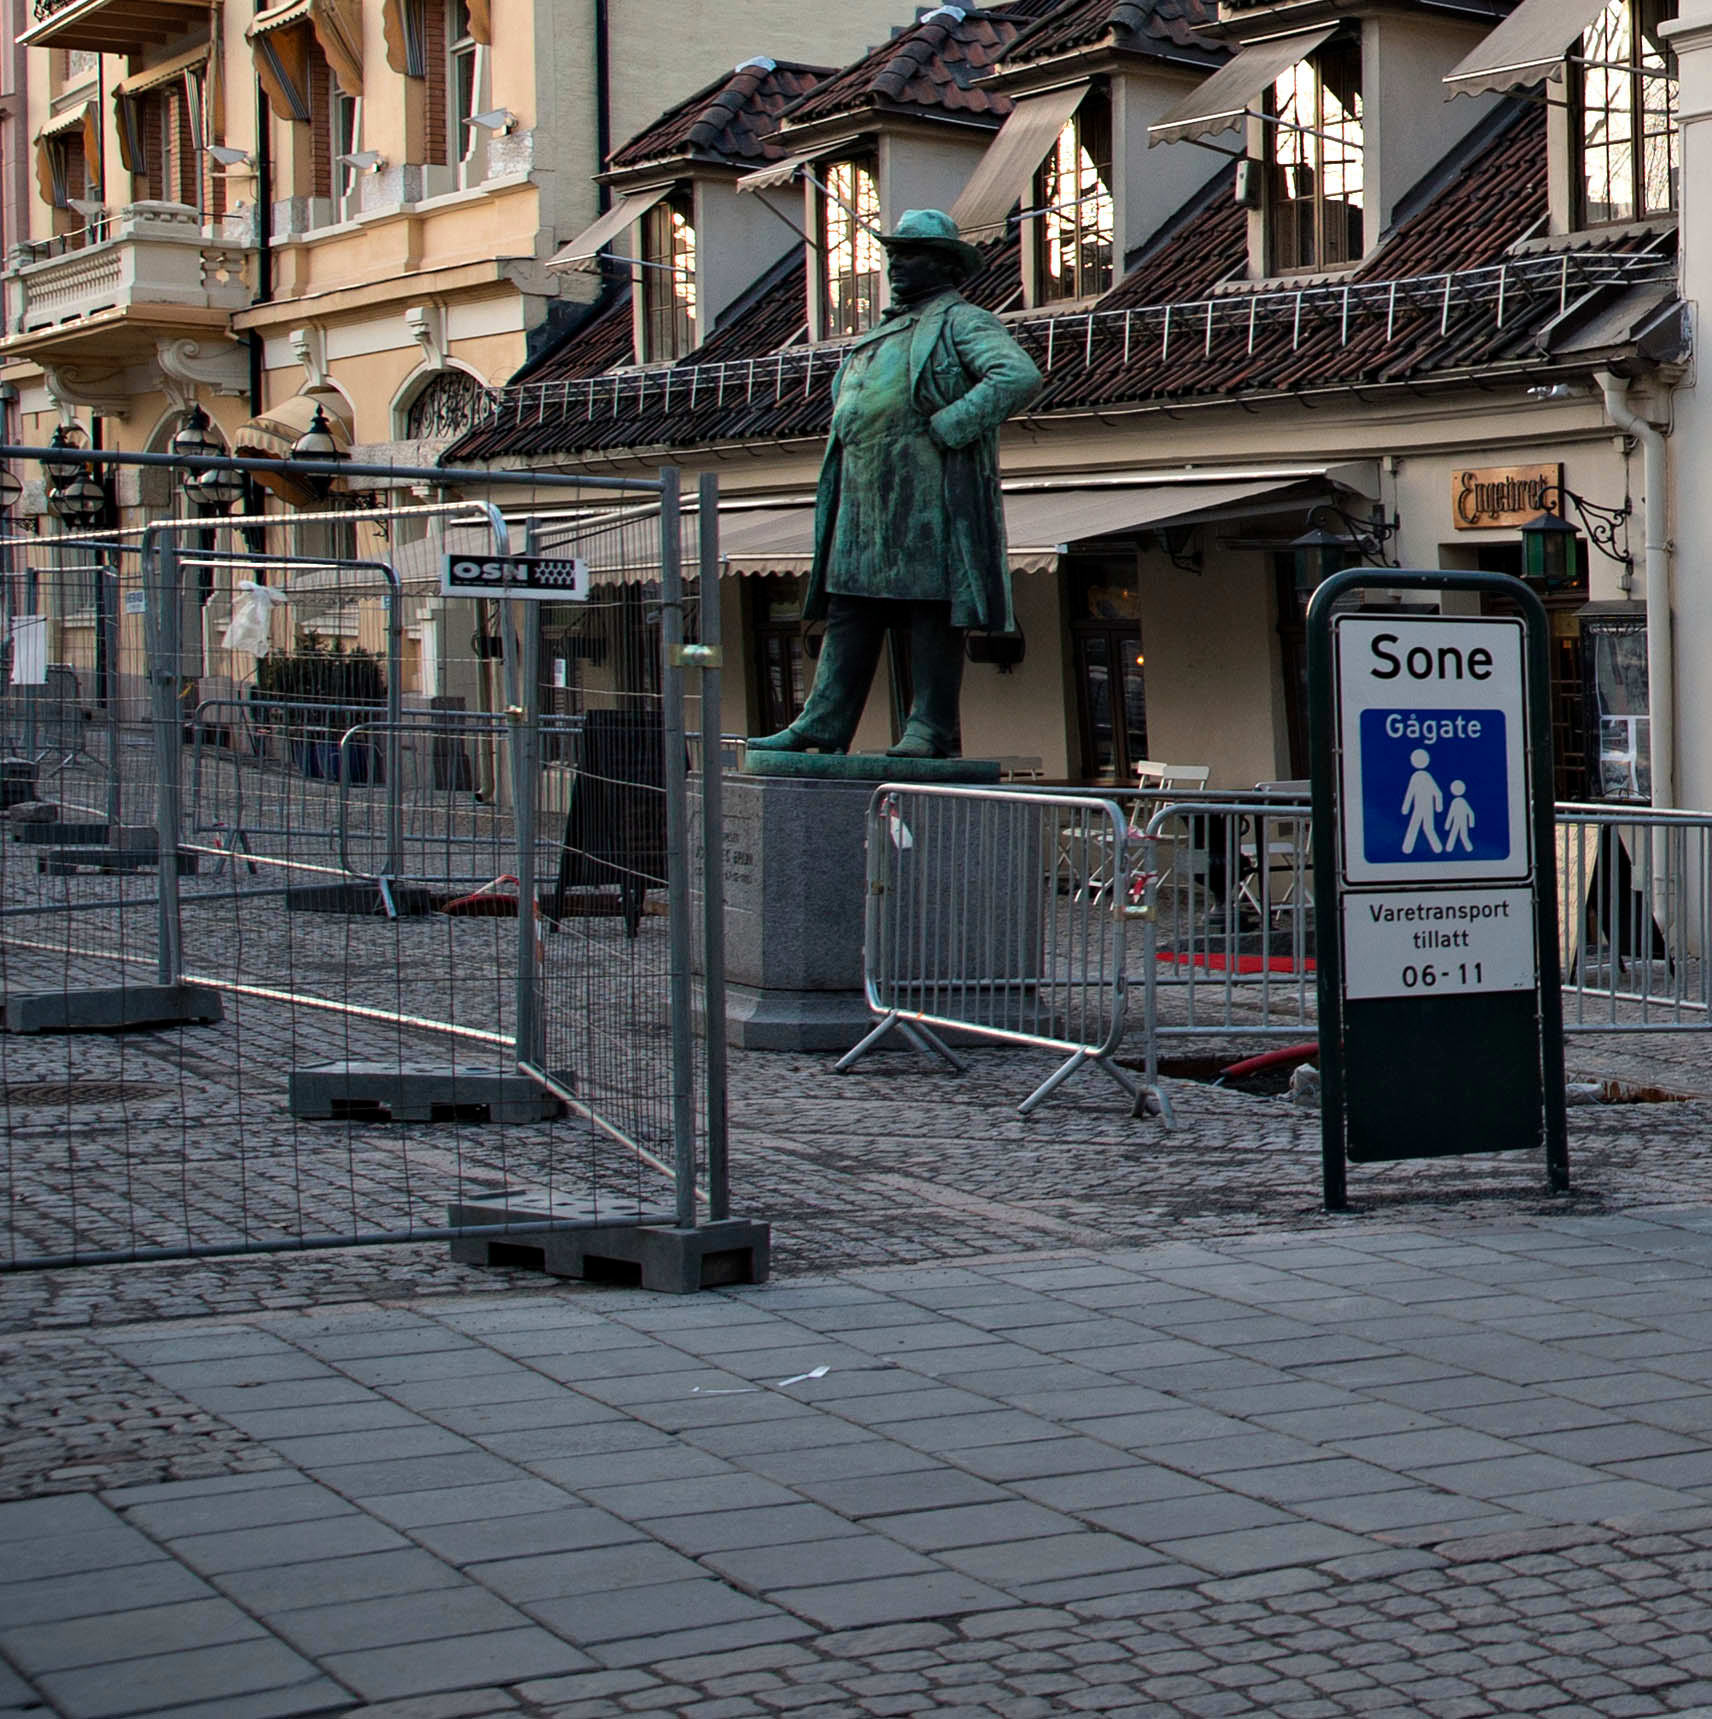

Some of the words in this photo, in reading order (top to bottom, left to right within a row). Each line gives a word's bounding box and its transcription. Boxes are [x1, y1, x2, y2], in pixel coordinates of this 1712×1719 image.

[1458, 471, 1549, 525] Engebret
[453, 561, 529, 580] OSN
[1371, 633, 1493, 680] Sone
[1385, 713, 1482, 744] Gågate
[1369, 899, 1510, 923] Varetransport
[1413, 929, 1470, 949] tillatt
